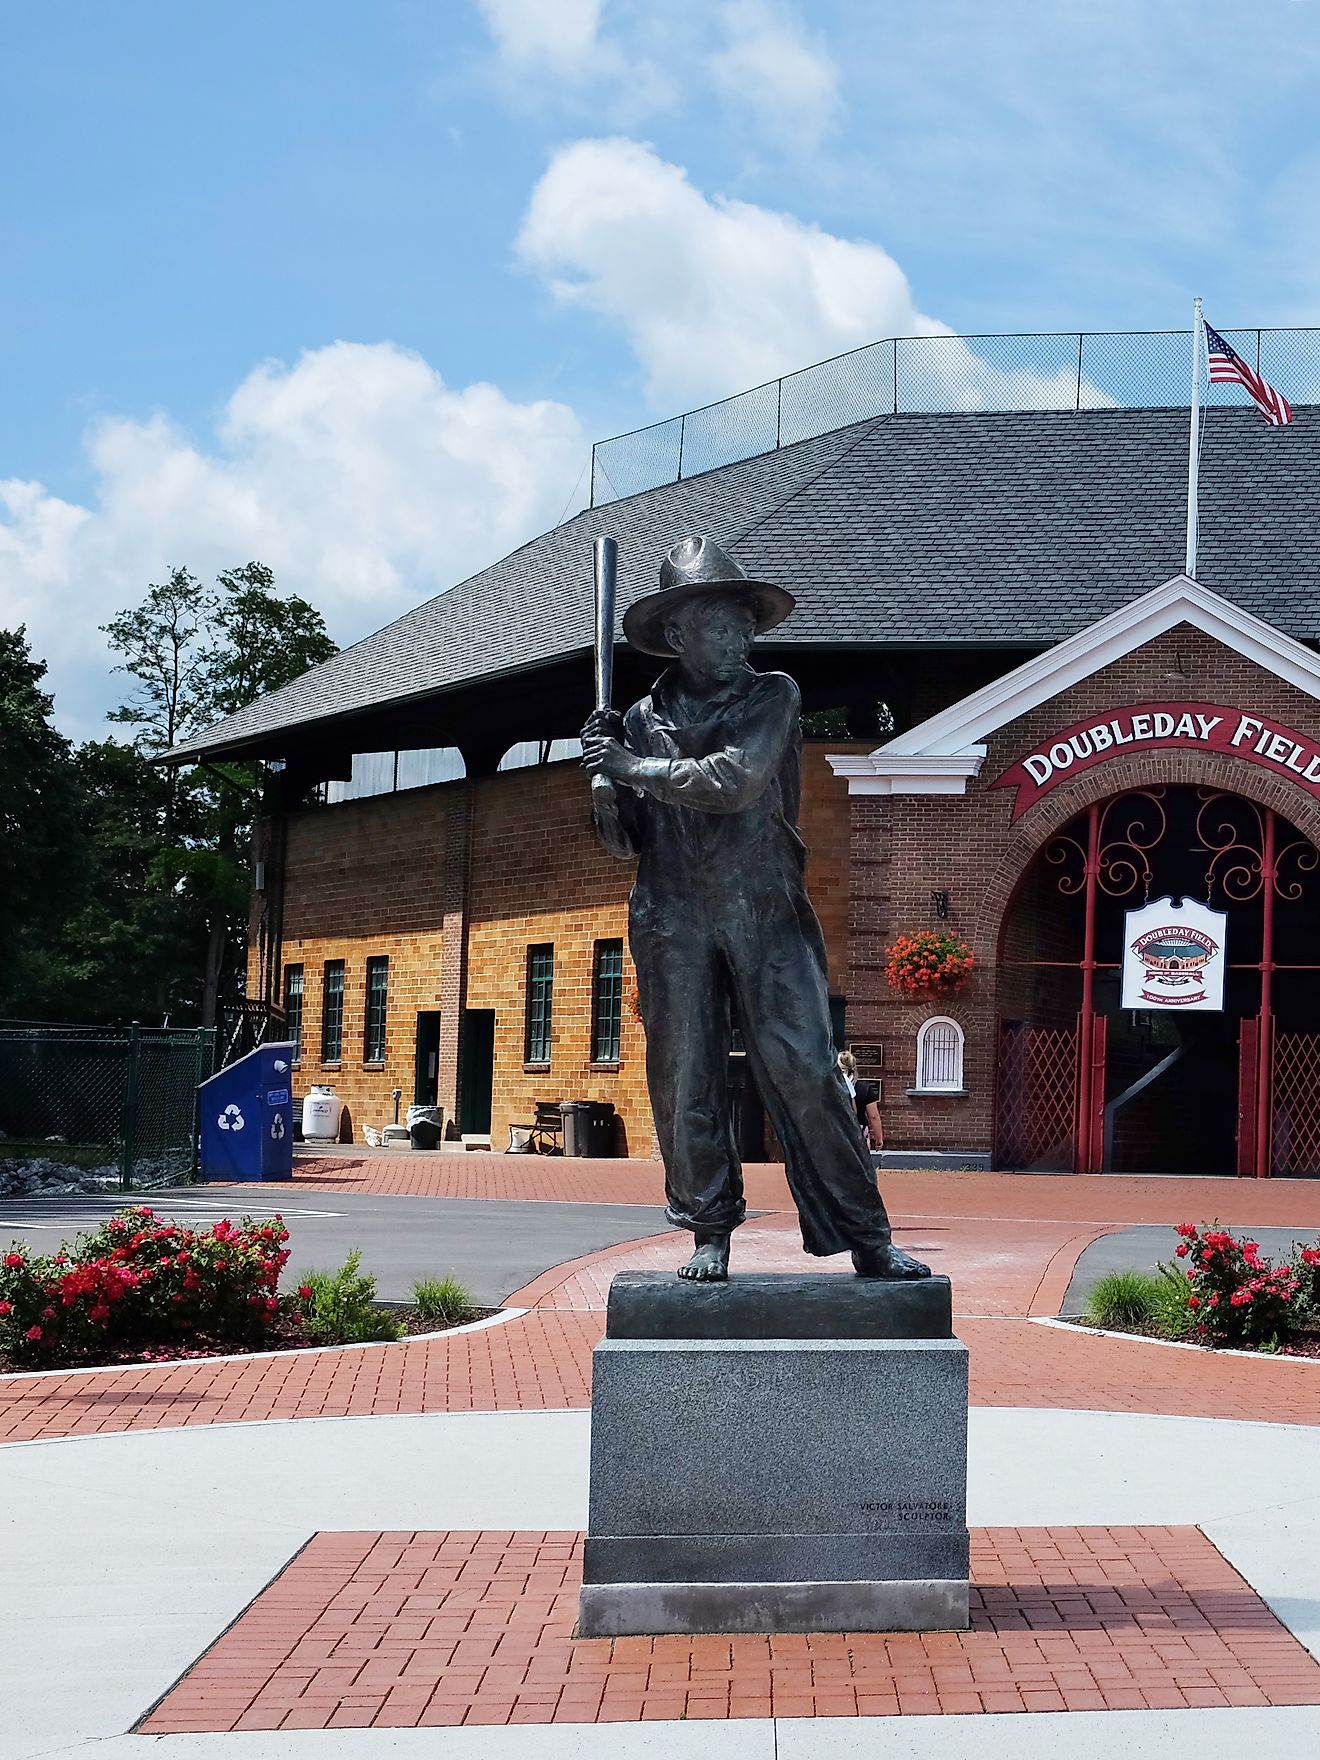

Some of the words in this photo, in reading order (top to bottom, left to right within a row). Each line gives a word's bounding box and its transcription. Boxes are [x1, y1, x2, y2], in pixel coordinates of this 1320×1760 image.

[1022, 712, 1224, 787] DOUBLEDAY
[1139, 928, 1190, 946] DOUBLEDAY
[1190, 931, 1212, 947] FIELD
[1164, 995, 1201, 1003] ANNIVERSARY
[860, 1502, 894, 1511] VICTOR
